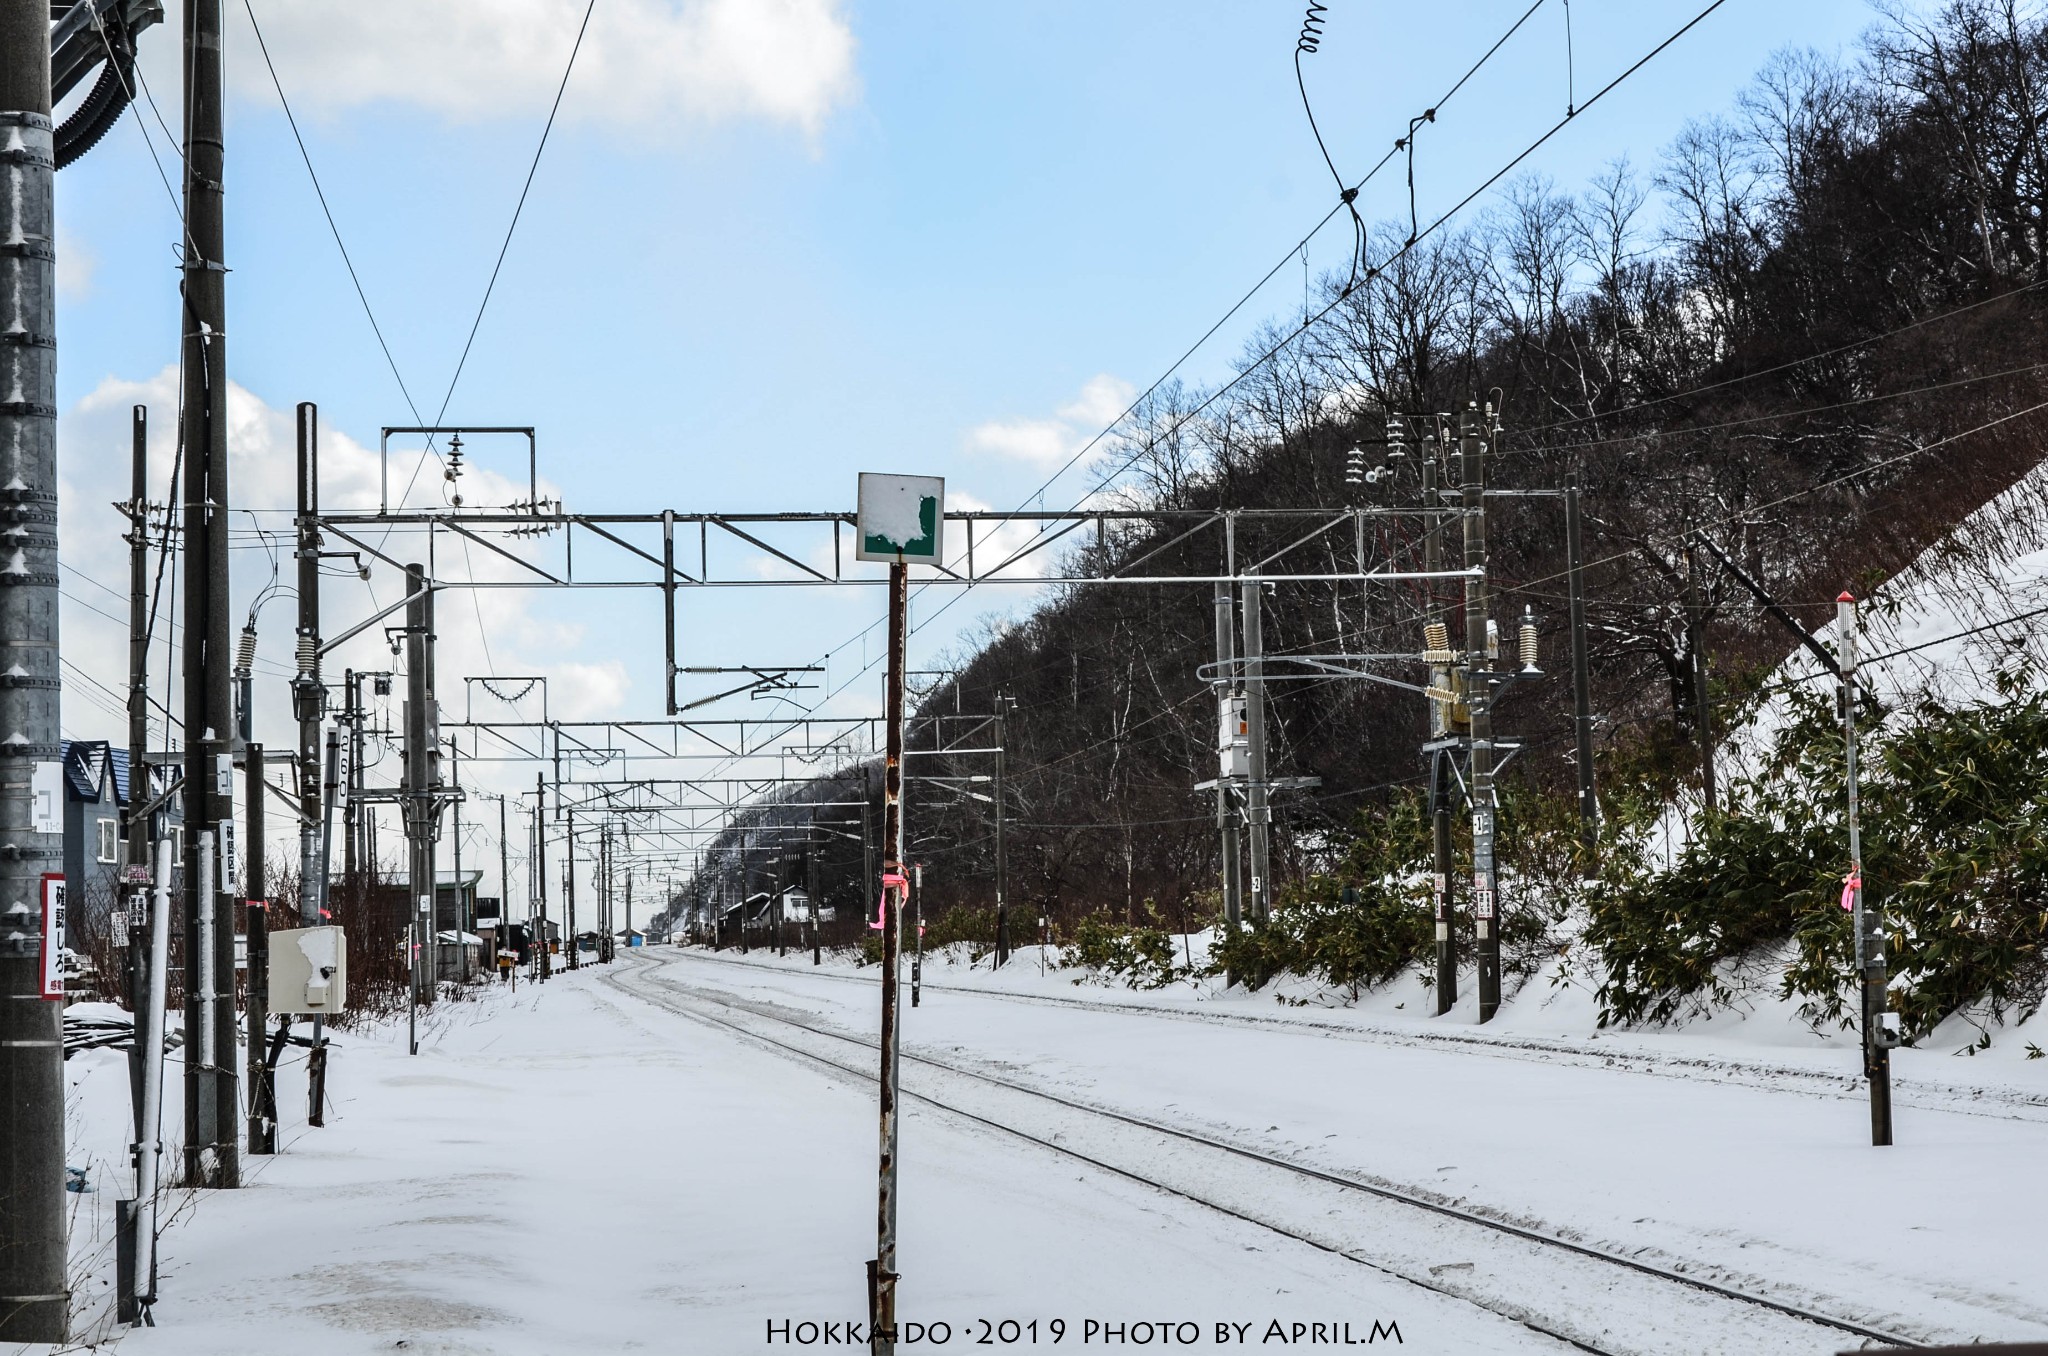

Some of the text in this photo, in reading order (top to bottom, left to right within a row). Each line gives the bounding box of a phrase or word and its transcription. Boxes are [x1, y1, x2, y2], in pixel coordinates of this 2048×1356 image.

[339, 734, 349, 798] 260
[55, 886, 66, 974] 確認しろ
